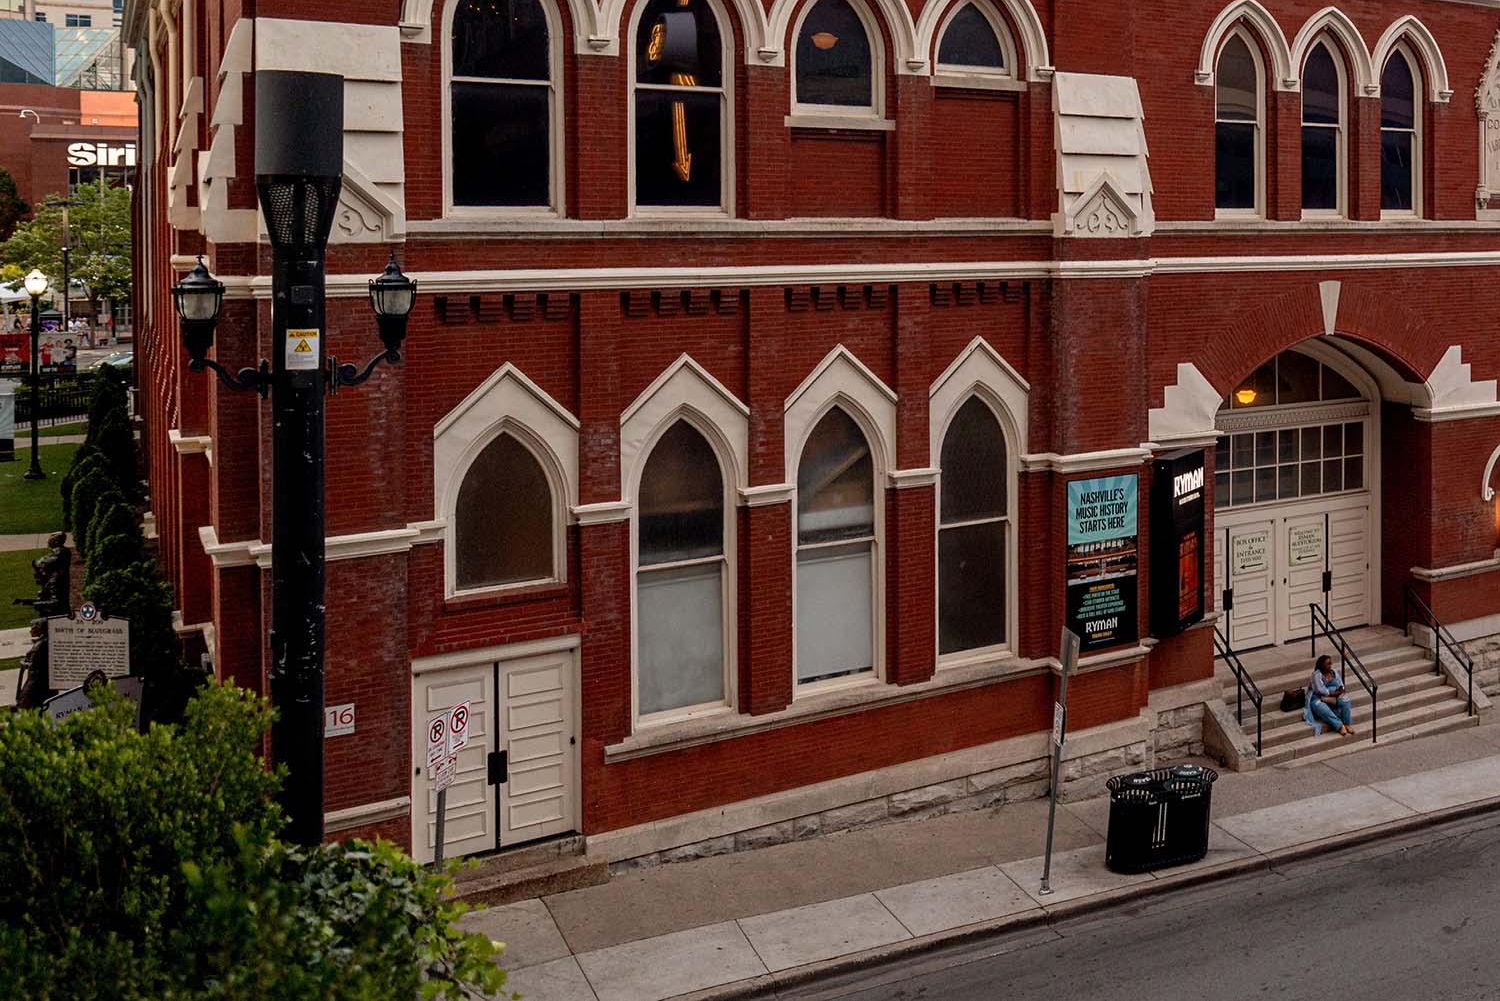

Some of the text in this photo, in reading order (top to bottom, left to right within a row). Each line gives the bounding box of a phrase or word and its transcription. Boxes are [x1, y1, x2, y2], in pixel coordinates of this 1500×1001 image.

[1173, 466, 1204, 498] RYMAN
[1080, 488, 1124, 505] NASHVILLE'S
[1075, 501, 1128, 520] MUSIC HISTORY
[1079, 516, 1125, 534] STARTS HERE
[1236, 548, 1266, 558] ENTRANCE
[1085, 616, 1118, 634] RYMAN
